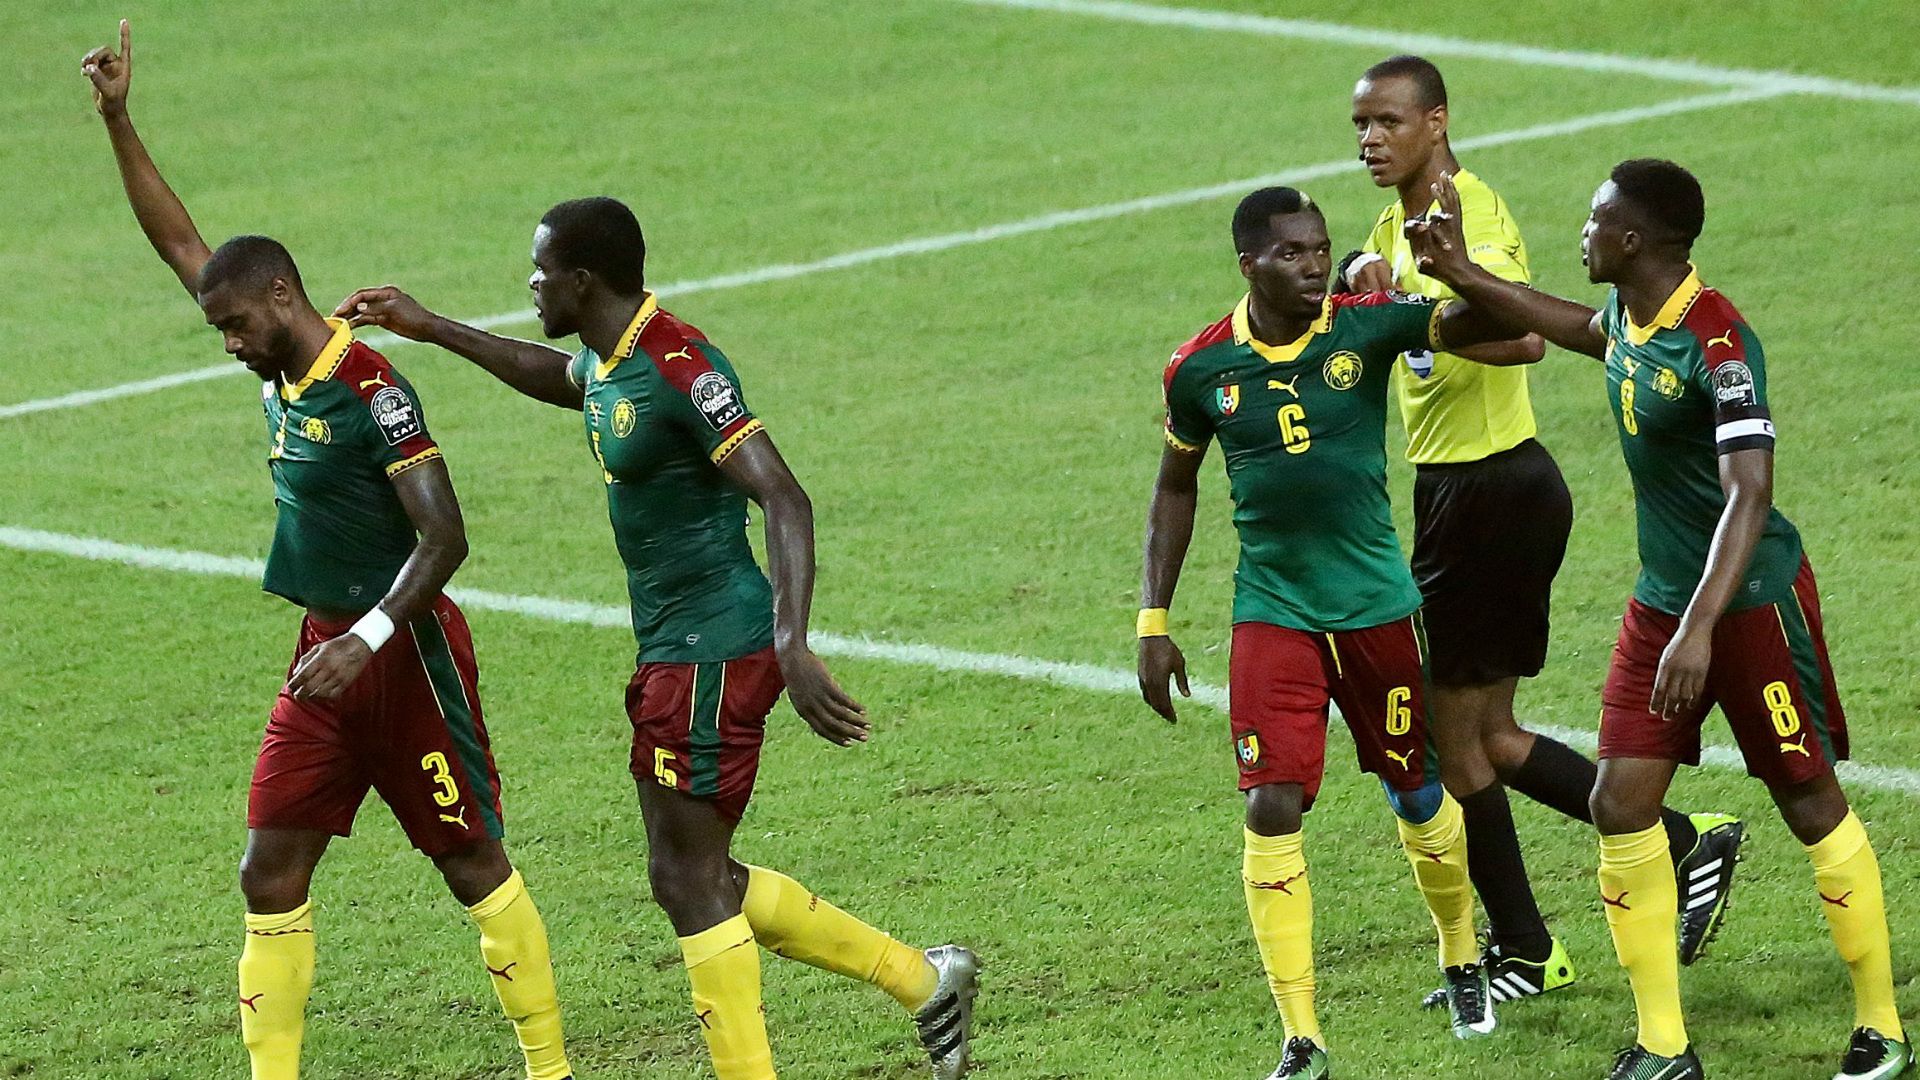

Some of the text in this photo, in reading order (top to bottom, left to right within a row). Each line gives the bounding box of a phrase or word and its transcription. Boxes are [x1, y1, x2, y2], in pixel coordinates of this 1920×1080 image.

[1277, 403, 1311, 454] 6
[1621, 378, 1638, 436] 8
[1386, 686, 1412, 736] 6
[1762, 681, 1801, 737] 8
[421, 751, 459, 807] 3
[654, 746, 678, 790] 5
